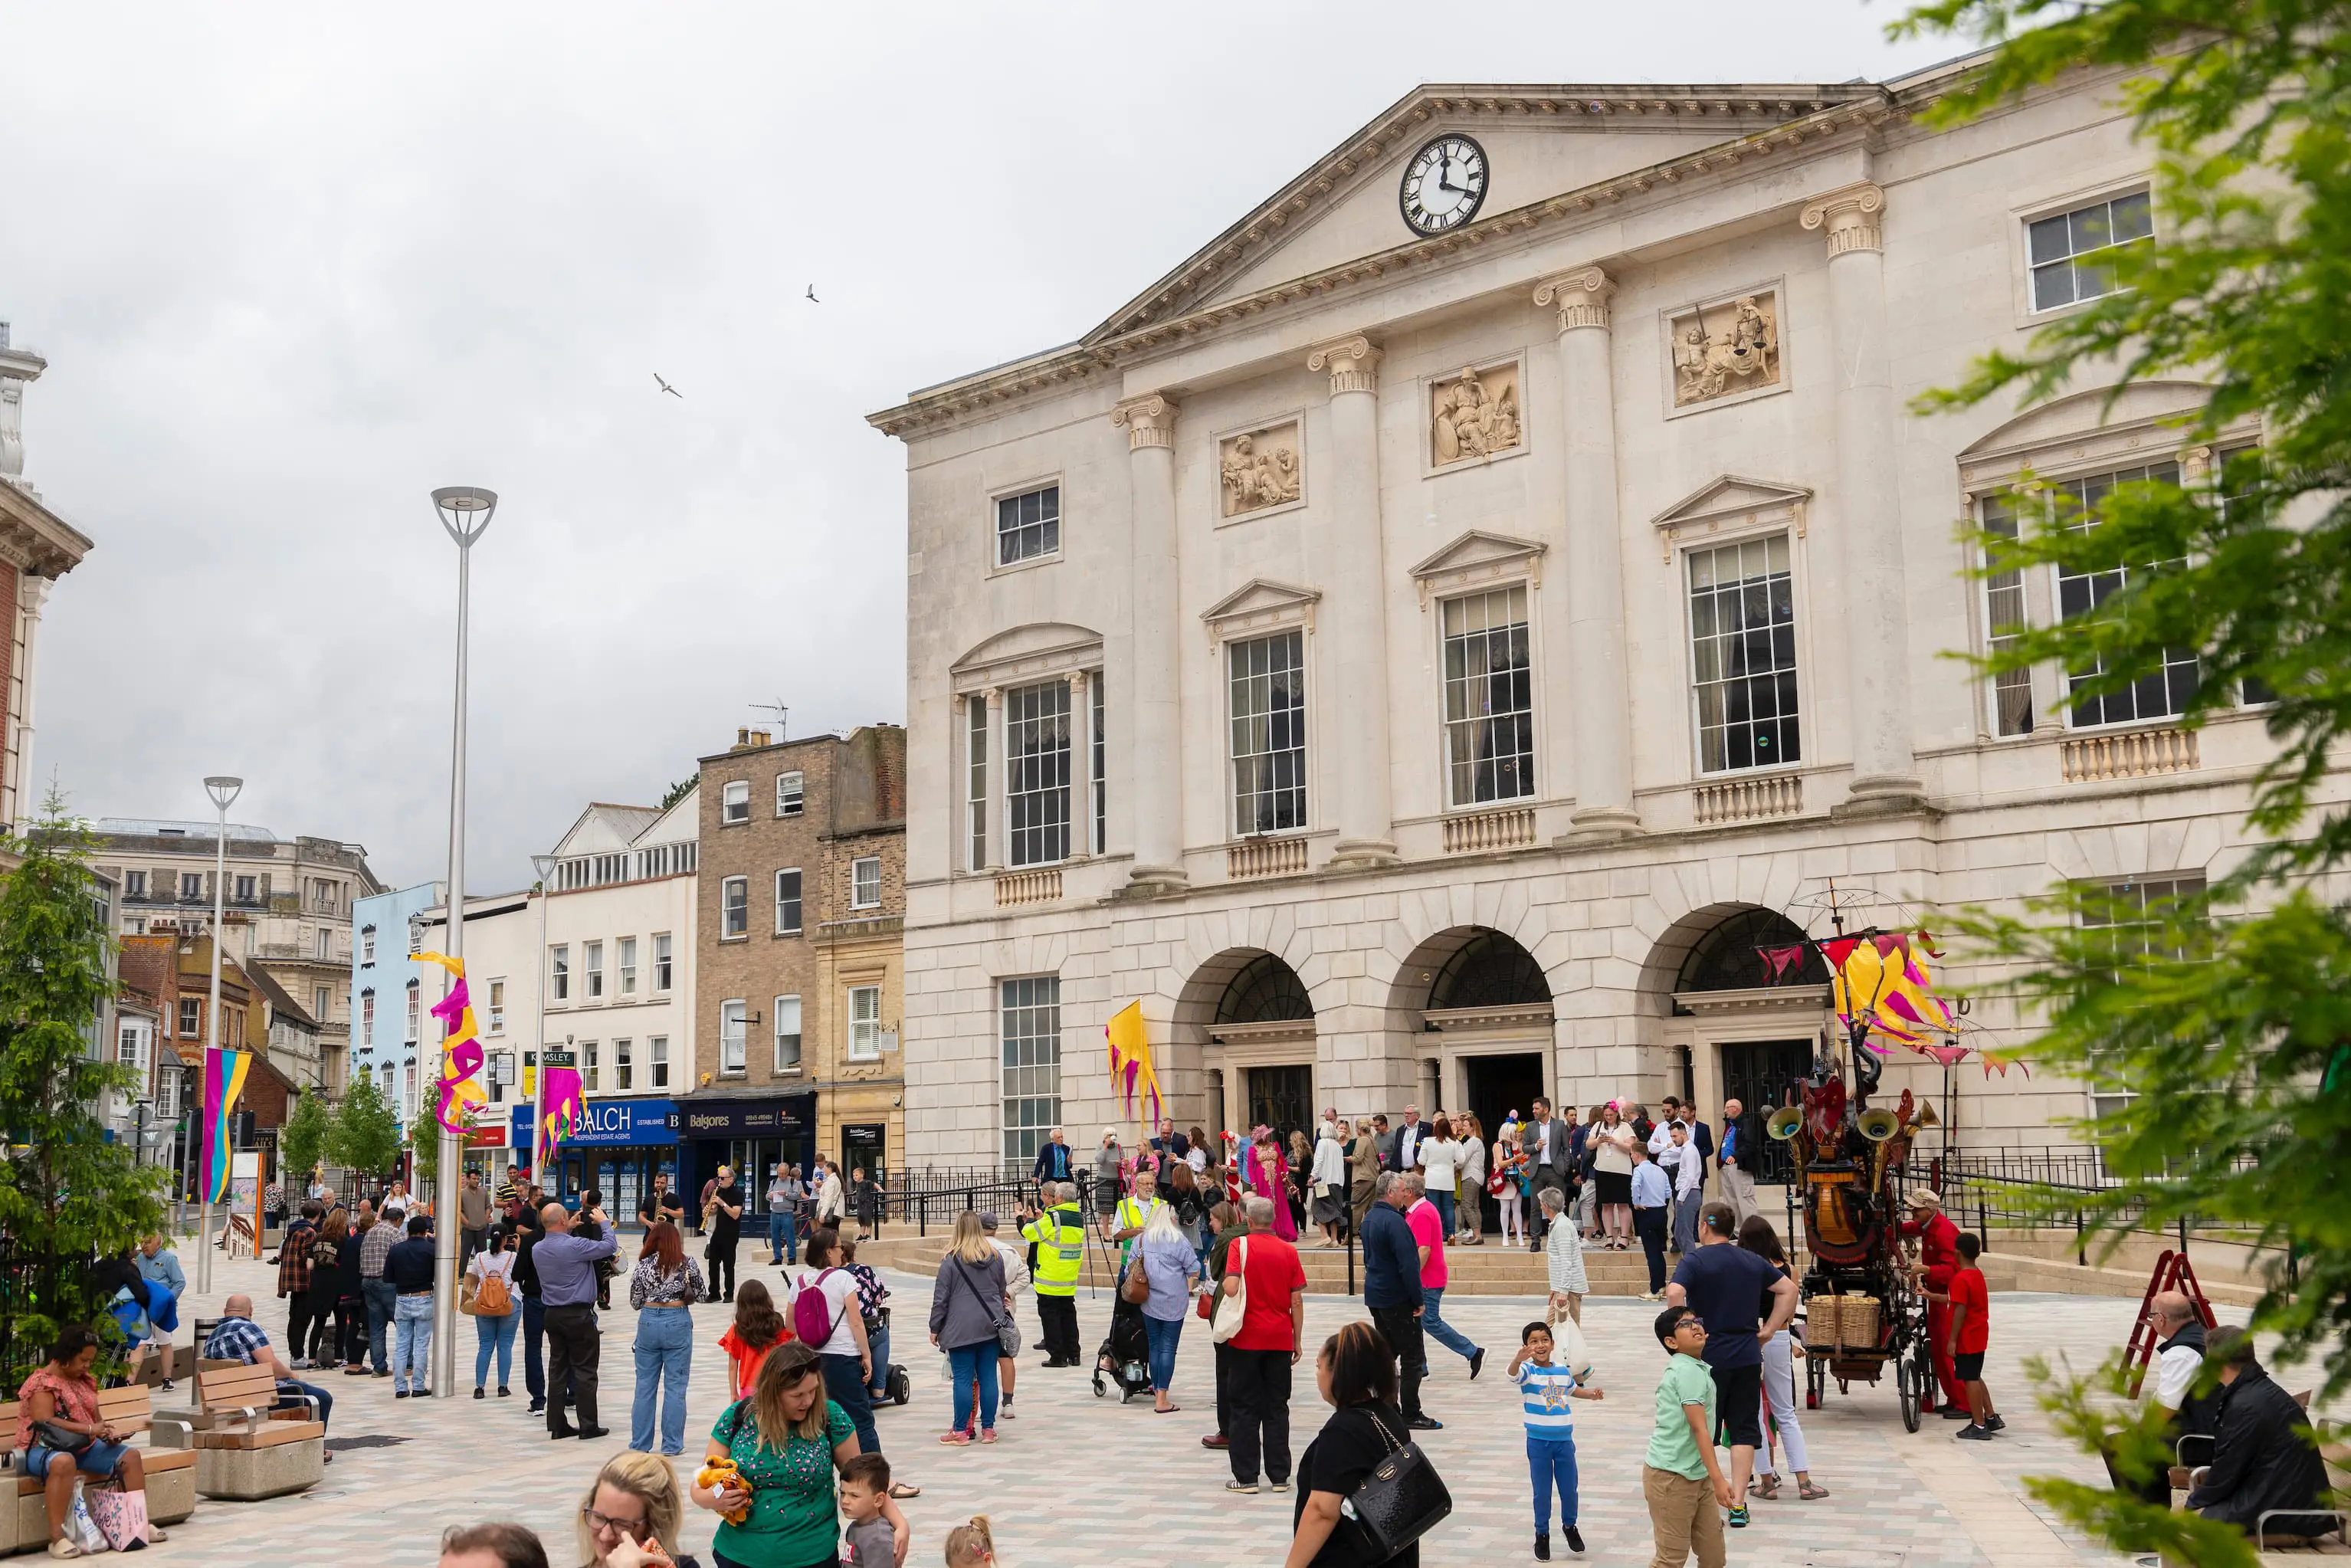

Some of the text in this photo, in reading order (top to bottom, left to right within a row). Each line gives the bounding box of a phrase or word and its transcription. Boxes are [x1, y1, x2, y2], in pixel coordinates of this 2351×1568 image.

[531, 1053, 569, 1062] KMSLEY
[575, 1107, 631, 1132] BALCH
[670, 1115, 679, 1127] B
[690, 1114, 730, 1130] Balgores
